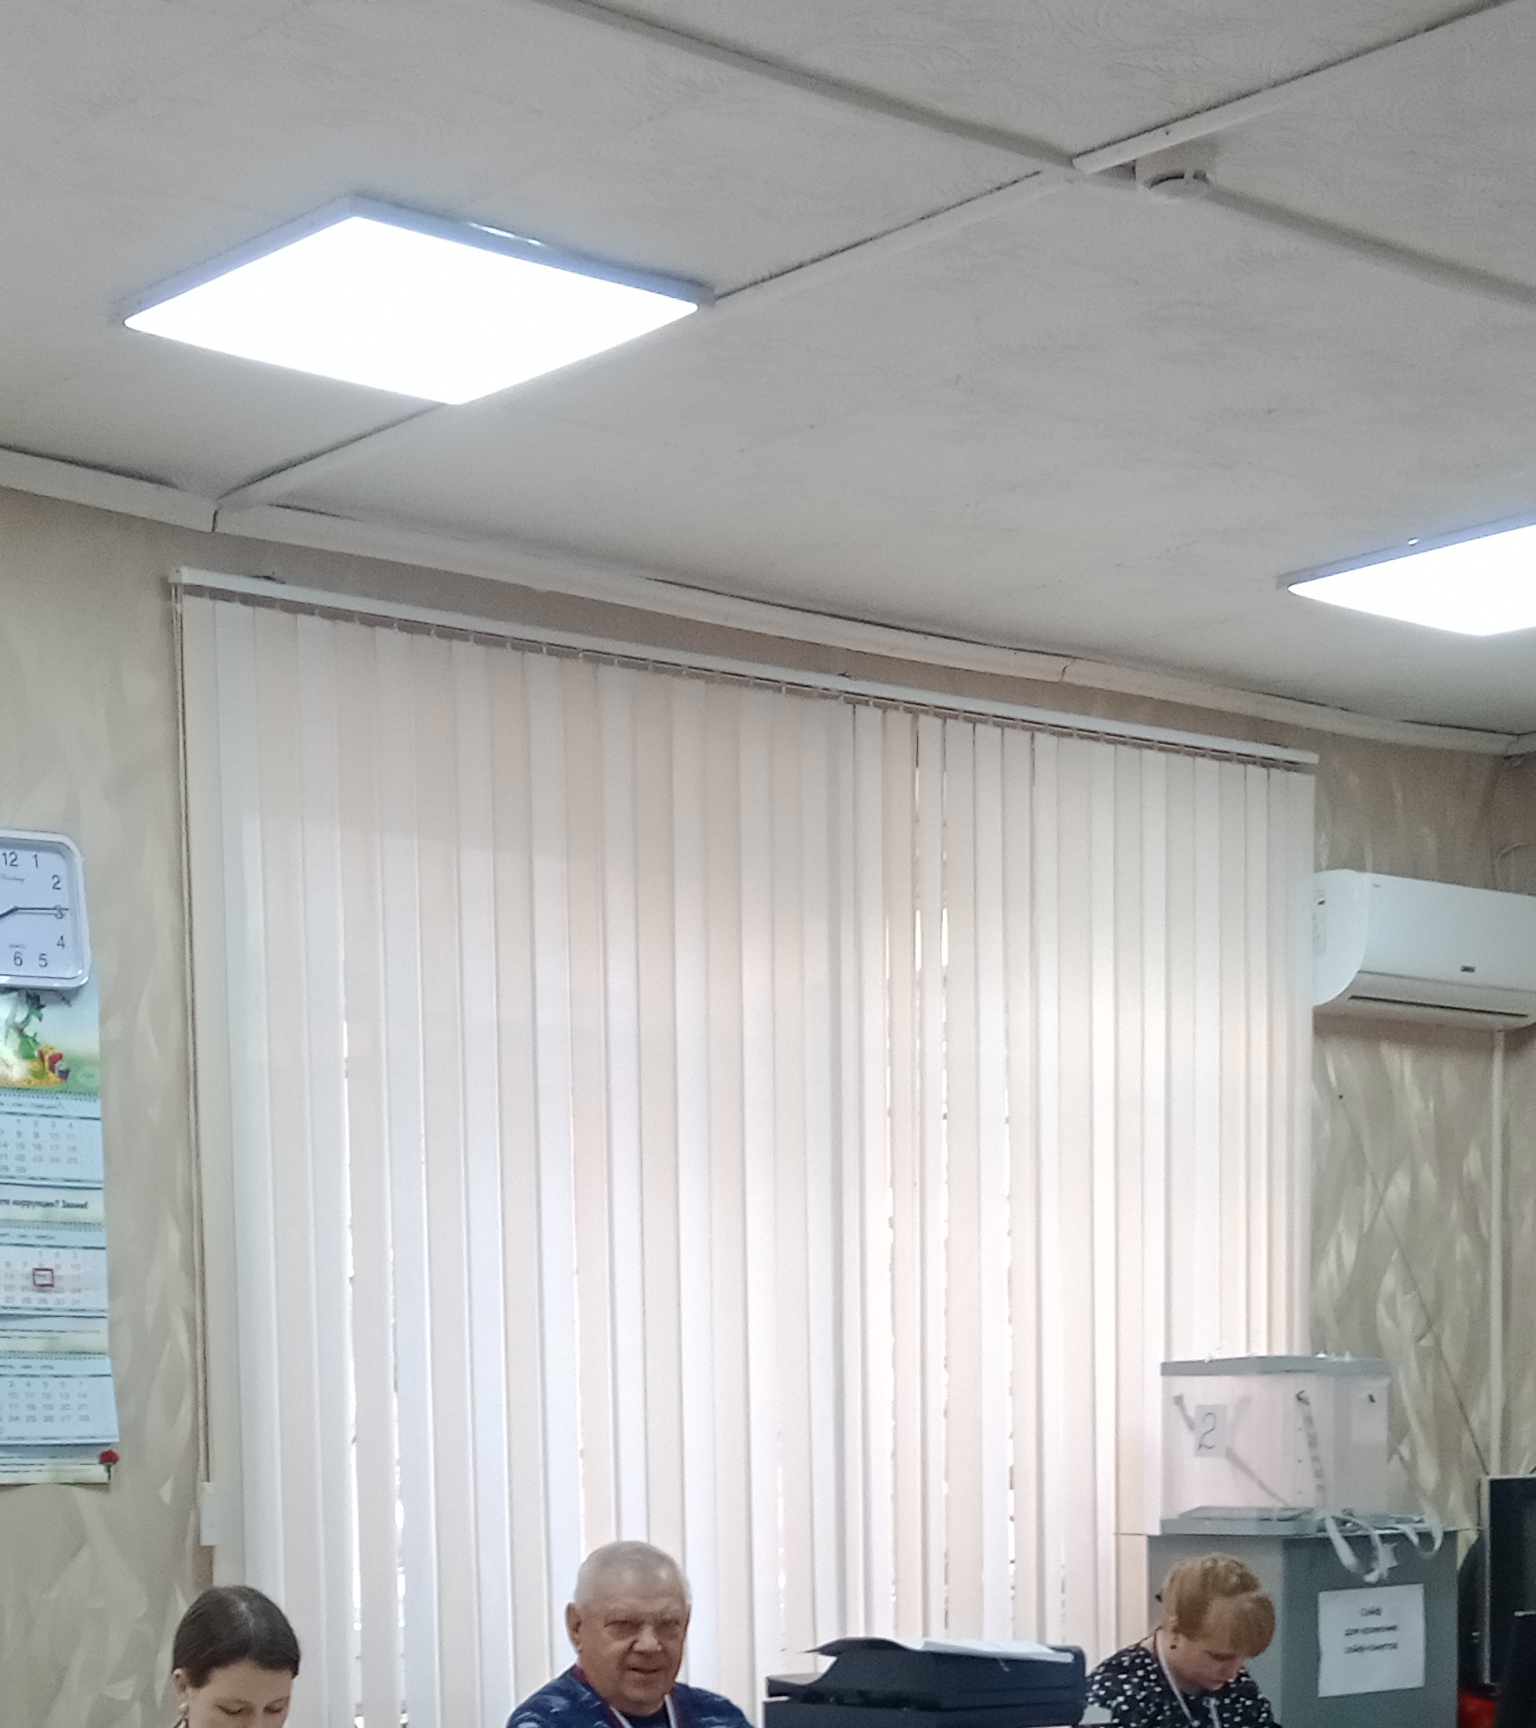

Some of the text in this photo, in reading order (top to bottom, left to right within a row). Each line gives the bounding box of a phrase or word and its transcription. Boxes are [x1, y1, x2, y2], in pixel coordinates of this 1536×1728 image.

[2, 852, 19, 867] 12
[33, 854, 39, 868] 1
[52, 875, 61, 890] 2
[57, 936, 65, 949] 4
[14, 952, 23, 967] 6
[39, 954, 48, 968] 5
[1198, 1412, 1215, 1451] 2
